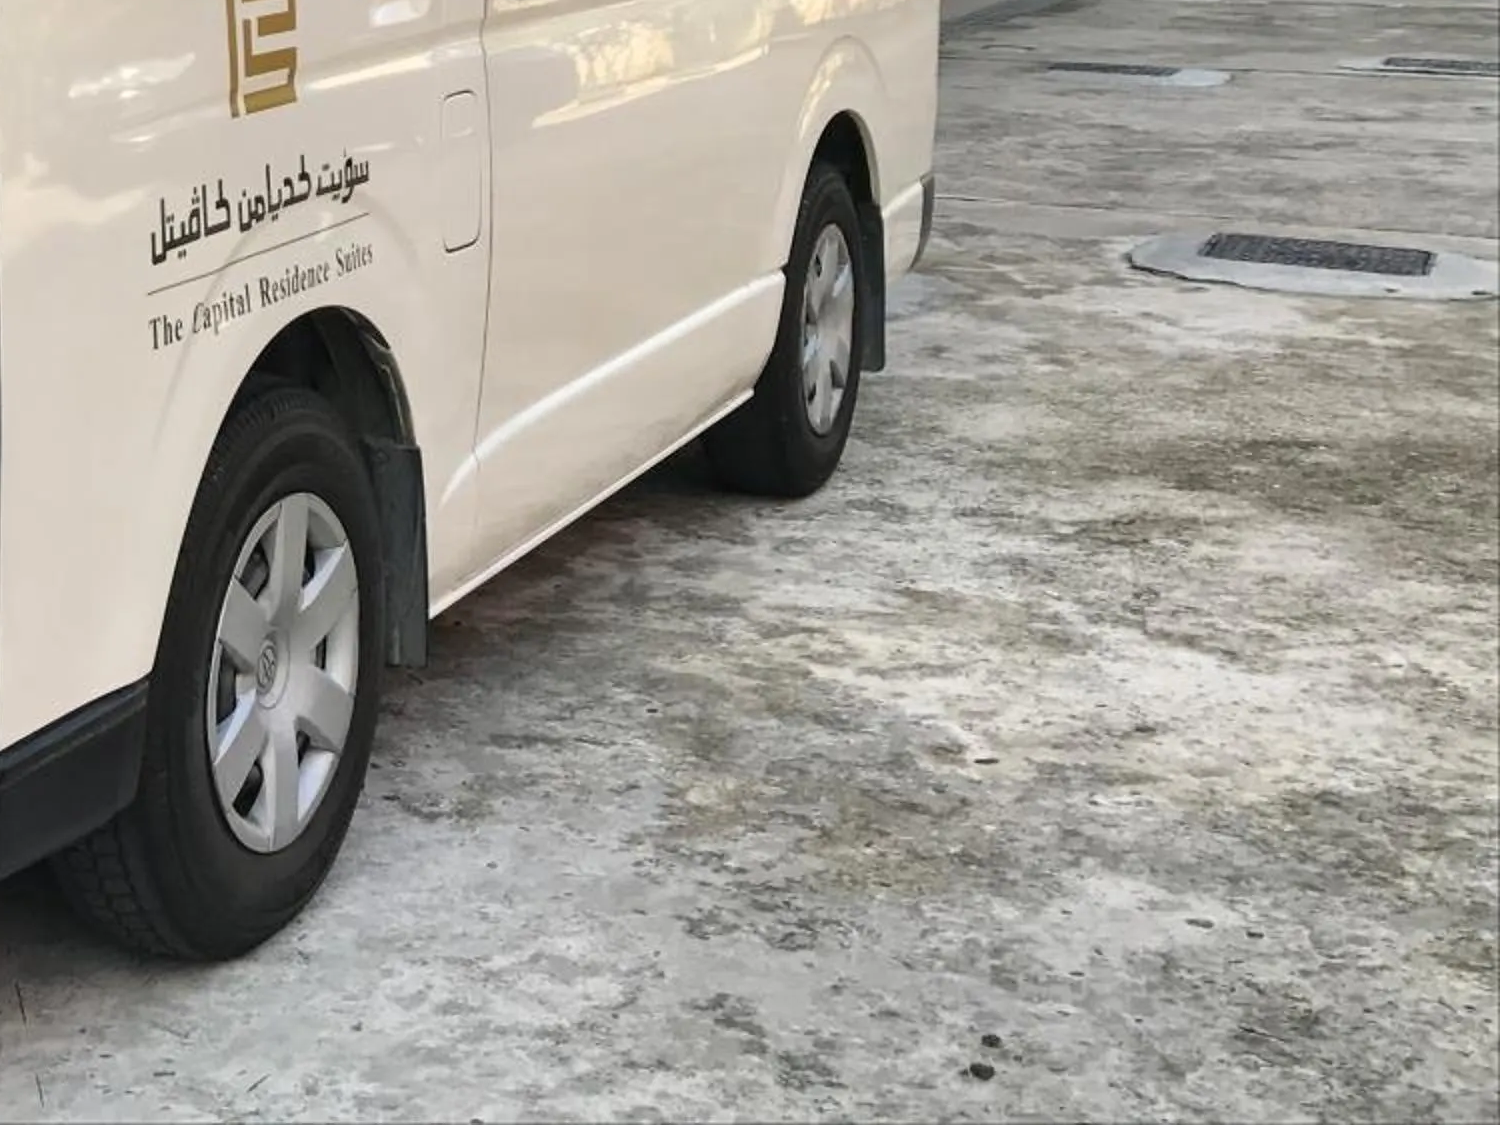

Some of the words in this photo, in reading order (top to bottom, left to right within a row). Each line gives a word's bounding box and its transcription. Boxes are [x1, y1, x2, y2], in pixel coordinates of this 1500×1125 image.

[148, 314, 183, 350] The
[192, 282, 251, 336] Capital
[259, 263, 330, 308] Residence
[335, 242, 373, 277] Suites
